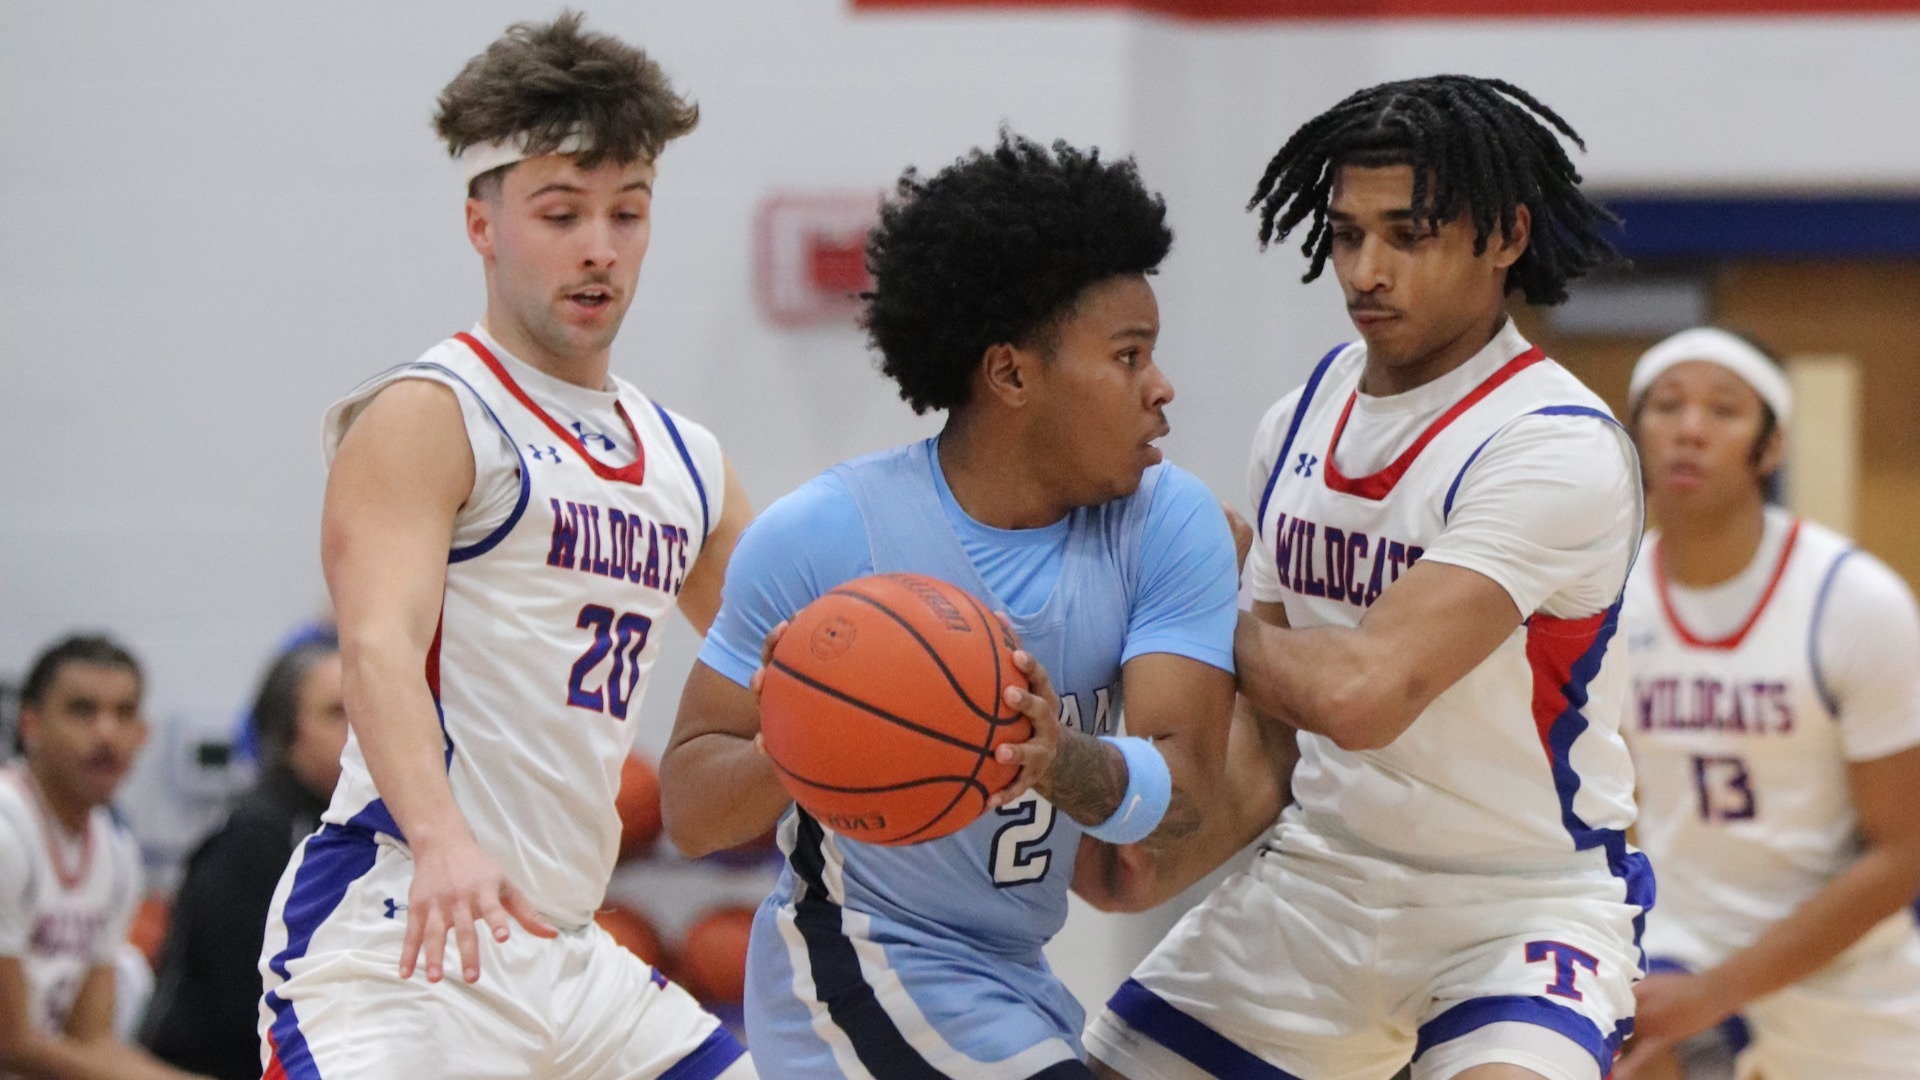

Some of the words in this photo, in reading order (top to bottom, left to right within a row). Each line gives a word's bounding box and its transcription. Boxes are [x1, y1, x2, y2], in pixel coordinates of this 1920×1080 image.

[546, 497, 689, 596] WILDCATS
[567, 603, 652, 721] 20
[1692, 754, 1755, 821] 13
[988, 788, 1056, 889] 2
[1525, 940, 1599, 1002] T
